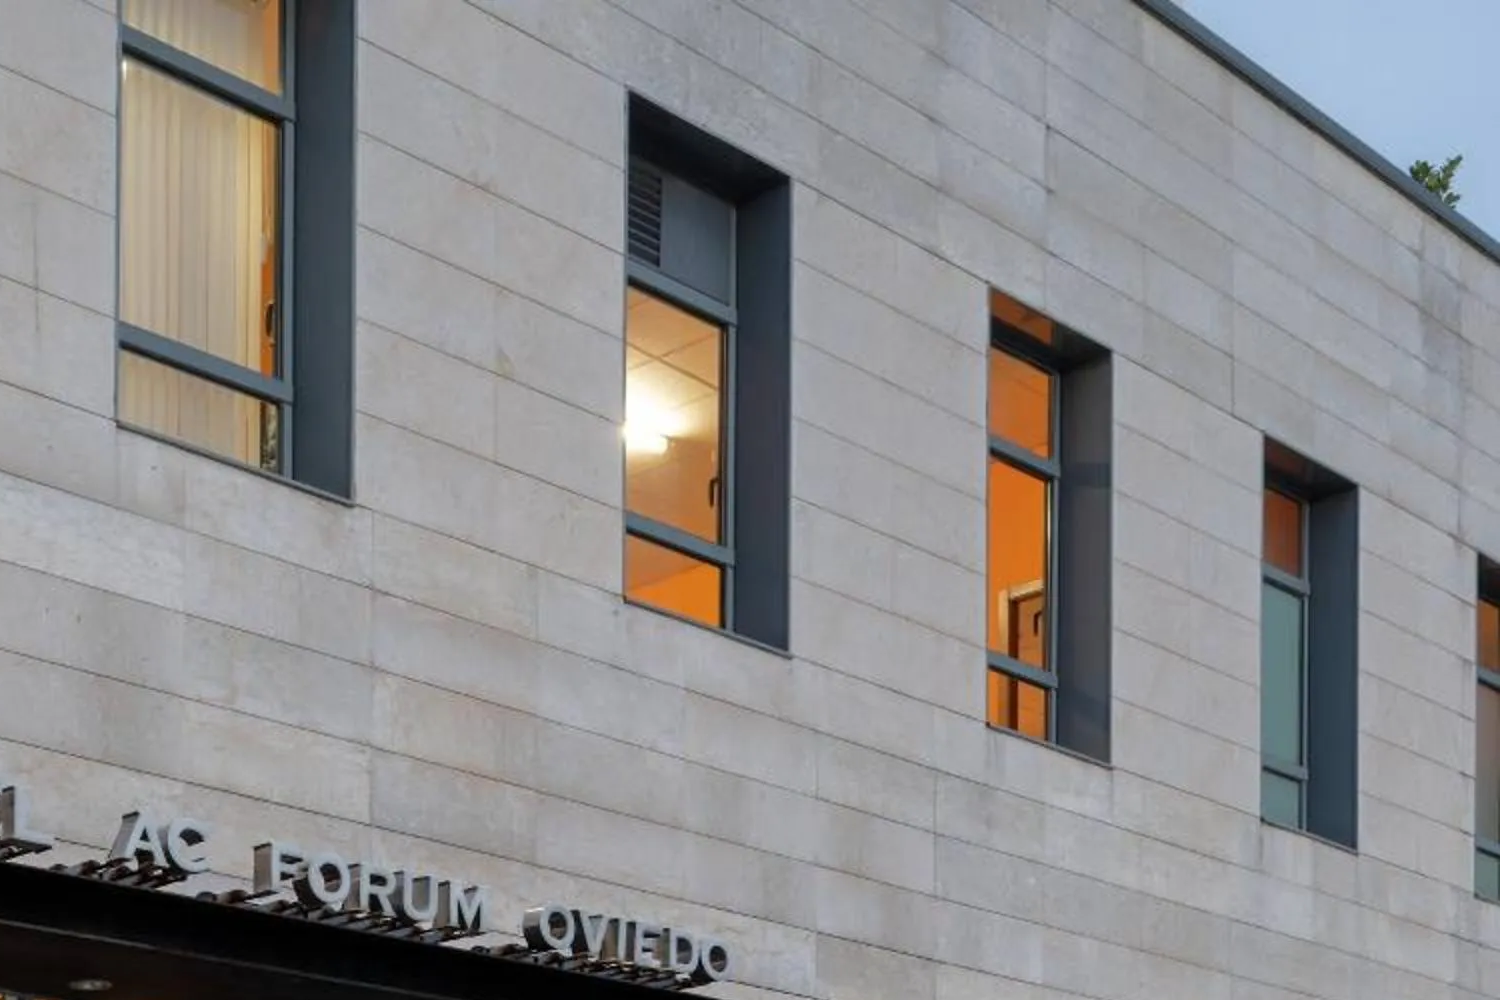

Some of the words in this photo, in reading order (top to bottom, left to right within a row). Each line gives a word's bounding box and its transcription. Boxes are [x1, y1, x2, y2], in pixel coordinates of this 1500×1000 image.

[109, 810, 212, 873] AC
[252, 839, 492, 932] FORUM
[522, 904, 737, 982] OVIEDO
